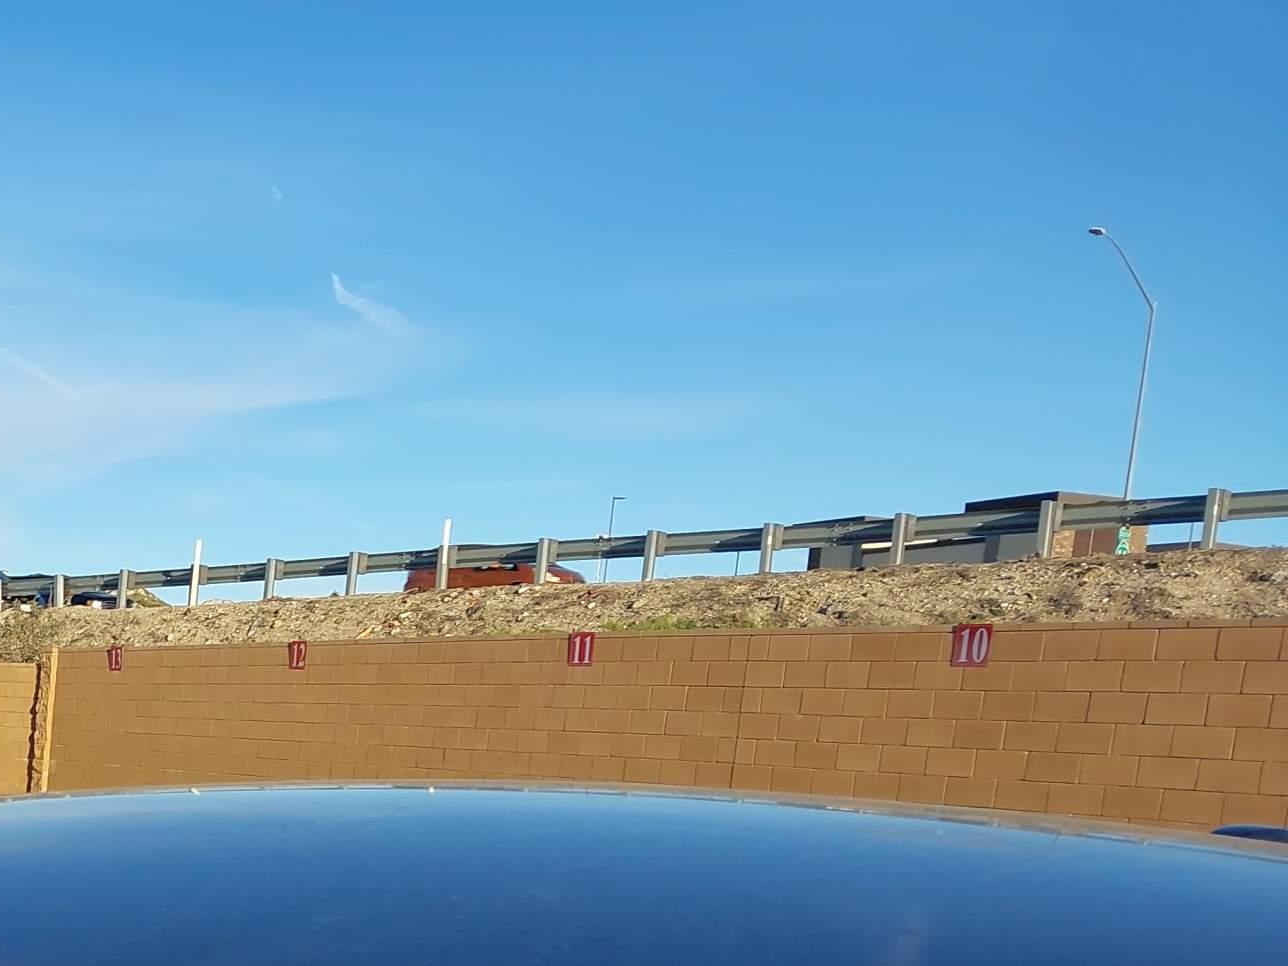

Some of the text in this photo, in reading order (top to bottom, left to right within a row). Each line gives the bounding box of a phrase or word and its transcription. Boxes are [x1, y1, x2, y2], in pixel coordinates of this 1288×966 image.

[111, 647, 122, 669] 13
[291, 643, 306, 667] 12
[572, 635, 592, 664] 11
[956, 627, 989, 663] 10
